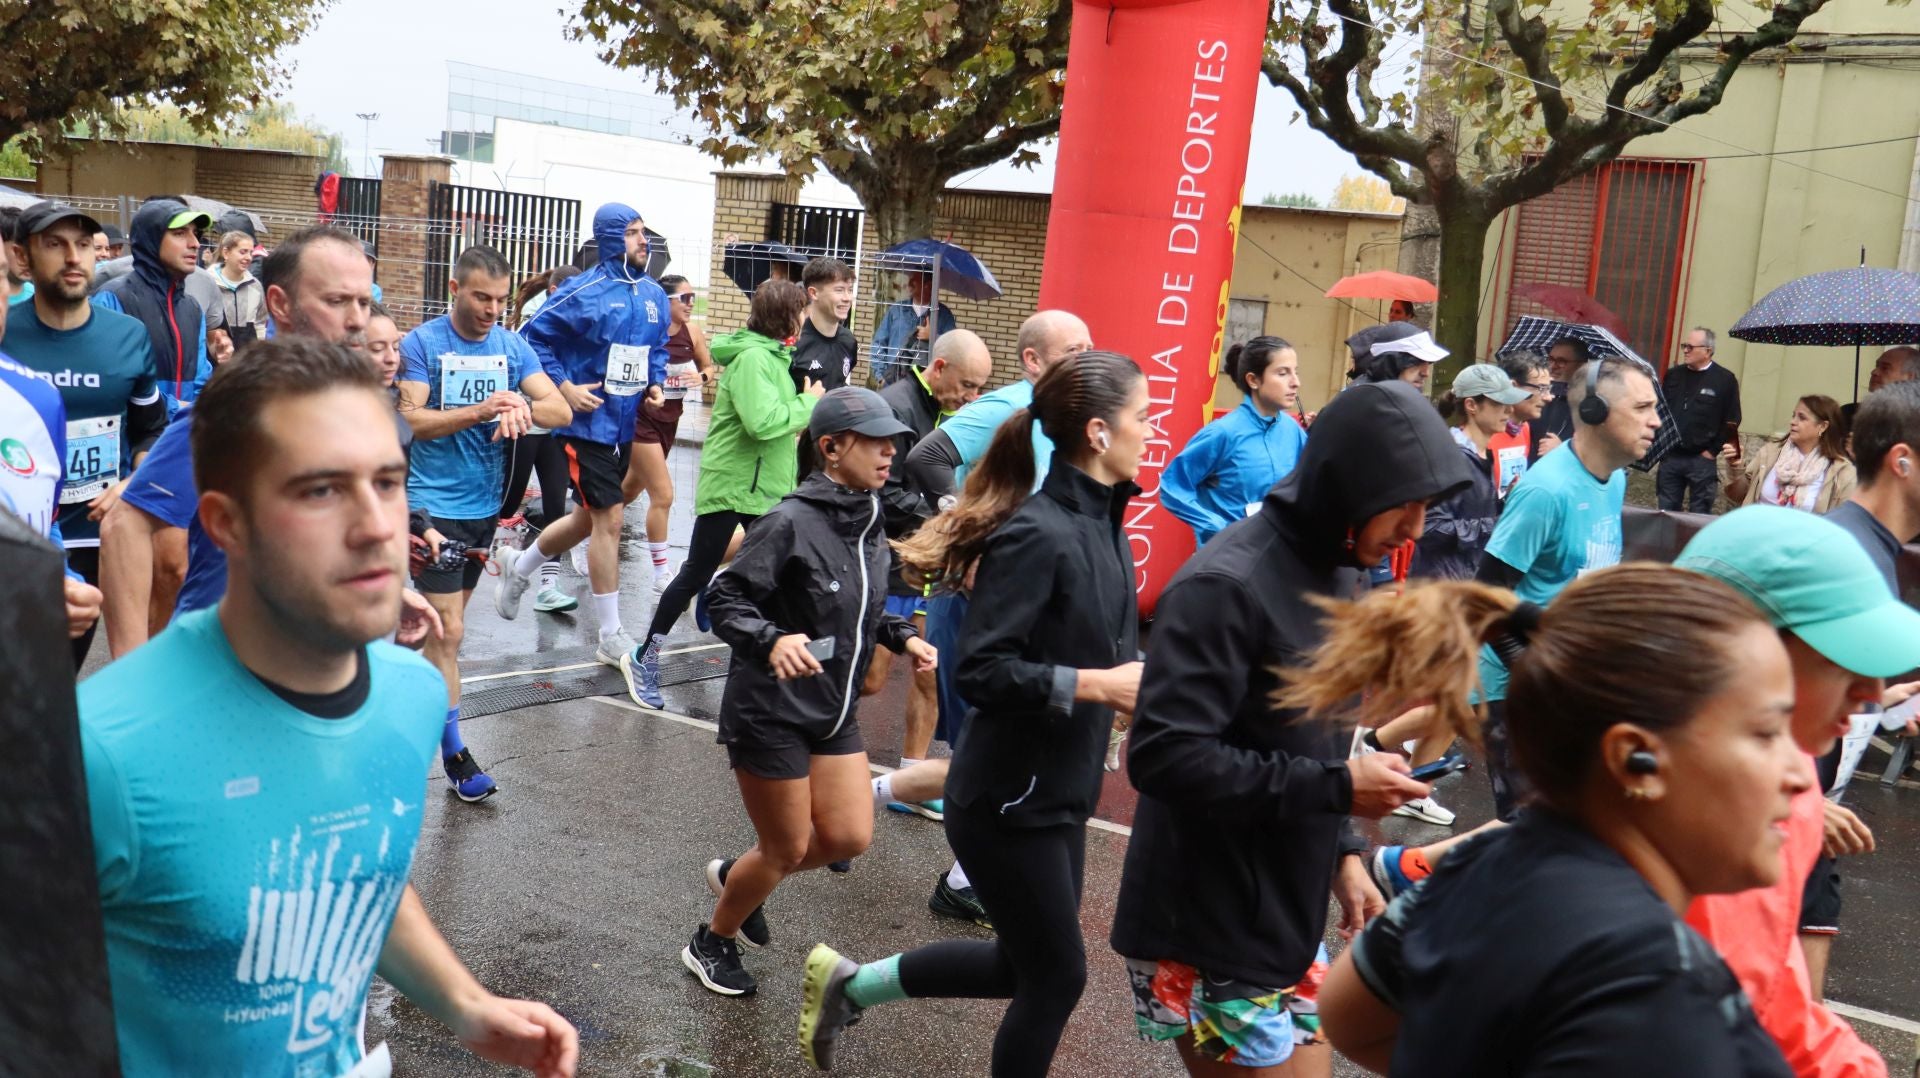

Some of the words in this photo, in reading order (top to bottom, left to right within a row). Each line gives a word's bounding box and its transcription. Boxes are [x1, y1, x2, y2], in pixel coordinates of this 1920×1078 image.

[1167, 39, 1228, 255] DEPORTES
[1156, 272, 1194, 327] DE
[460, 379, 496, 403] 489
[69, 446, 101, 478] 46
